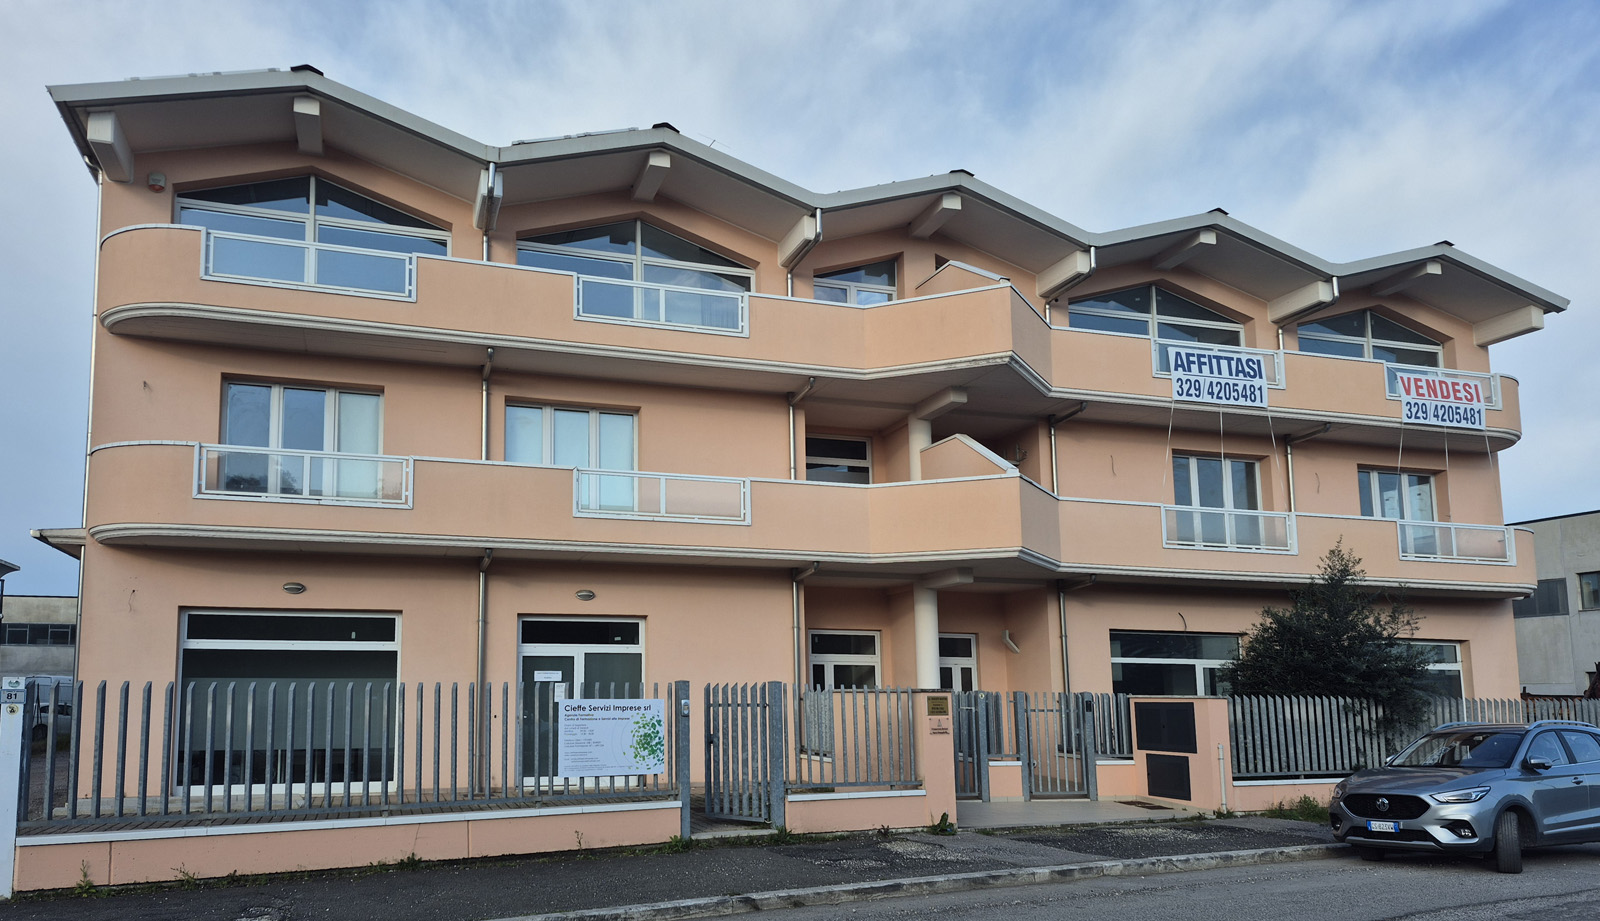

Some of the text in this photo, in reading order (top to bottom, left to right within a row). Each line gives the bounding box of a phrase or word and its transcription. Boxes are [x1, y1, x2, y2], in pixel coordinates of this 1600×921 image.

[1174, 351, 1263, 379] AFFITTASI
[1176, 378, 1263, 403] 329/4205481
[1400, 376, 1481, 403] VENDESI
[1405, 401, 1482, 426] 329/4205481
[6, 692, 17, 700] 81
[564, 704, 587, 712] Cieffe
[612, 704, 642, 713] Imprese
